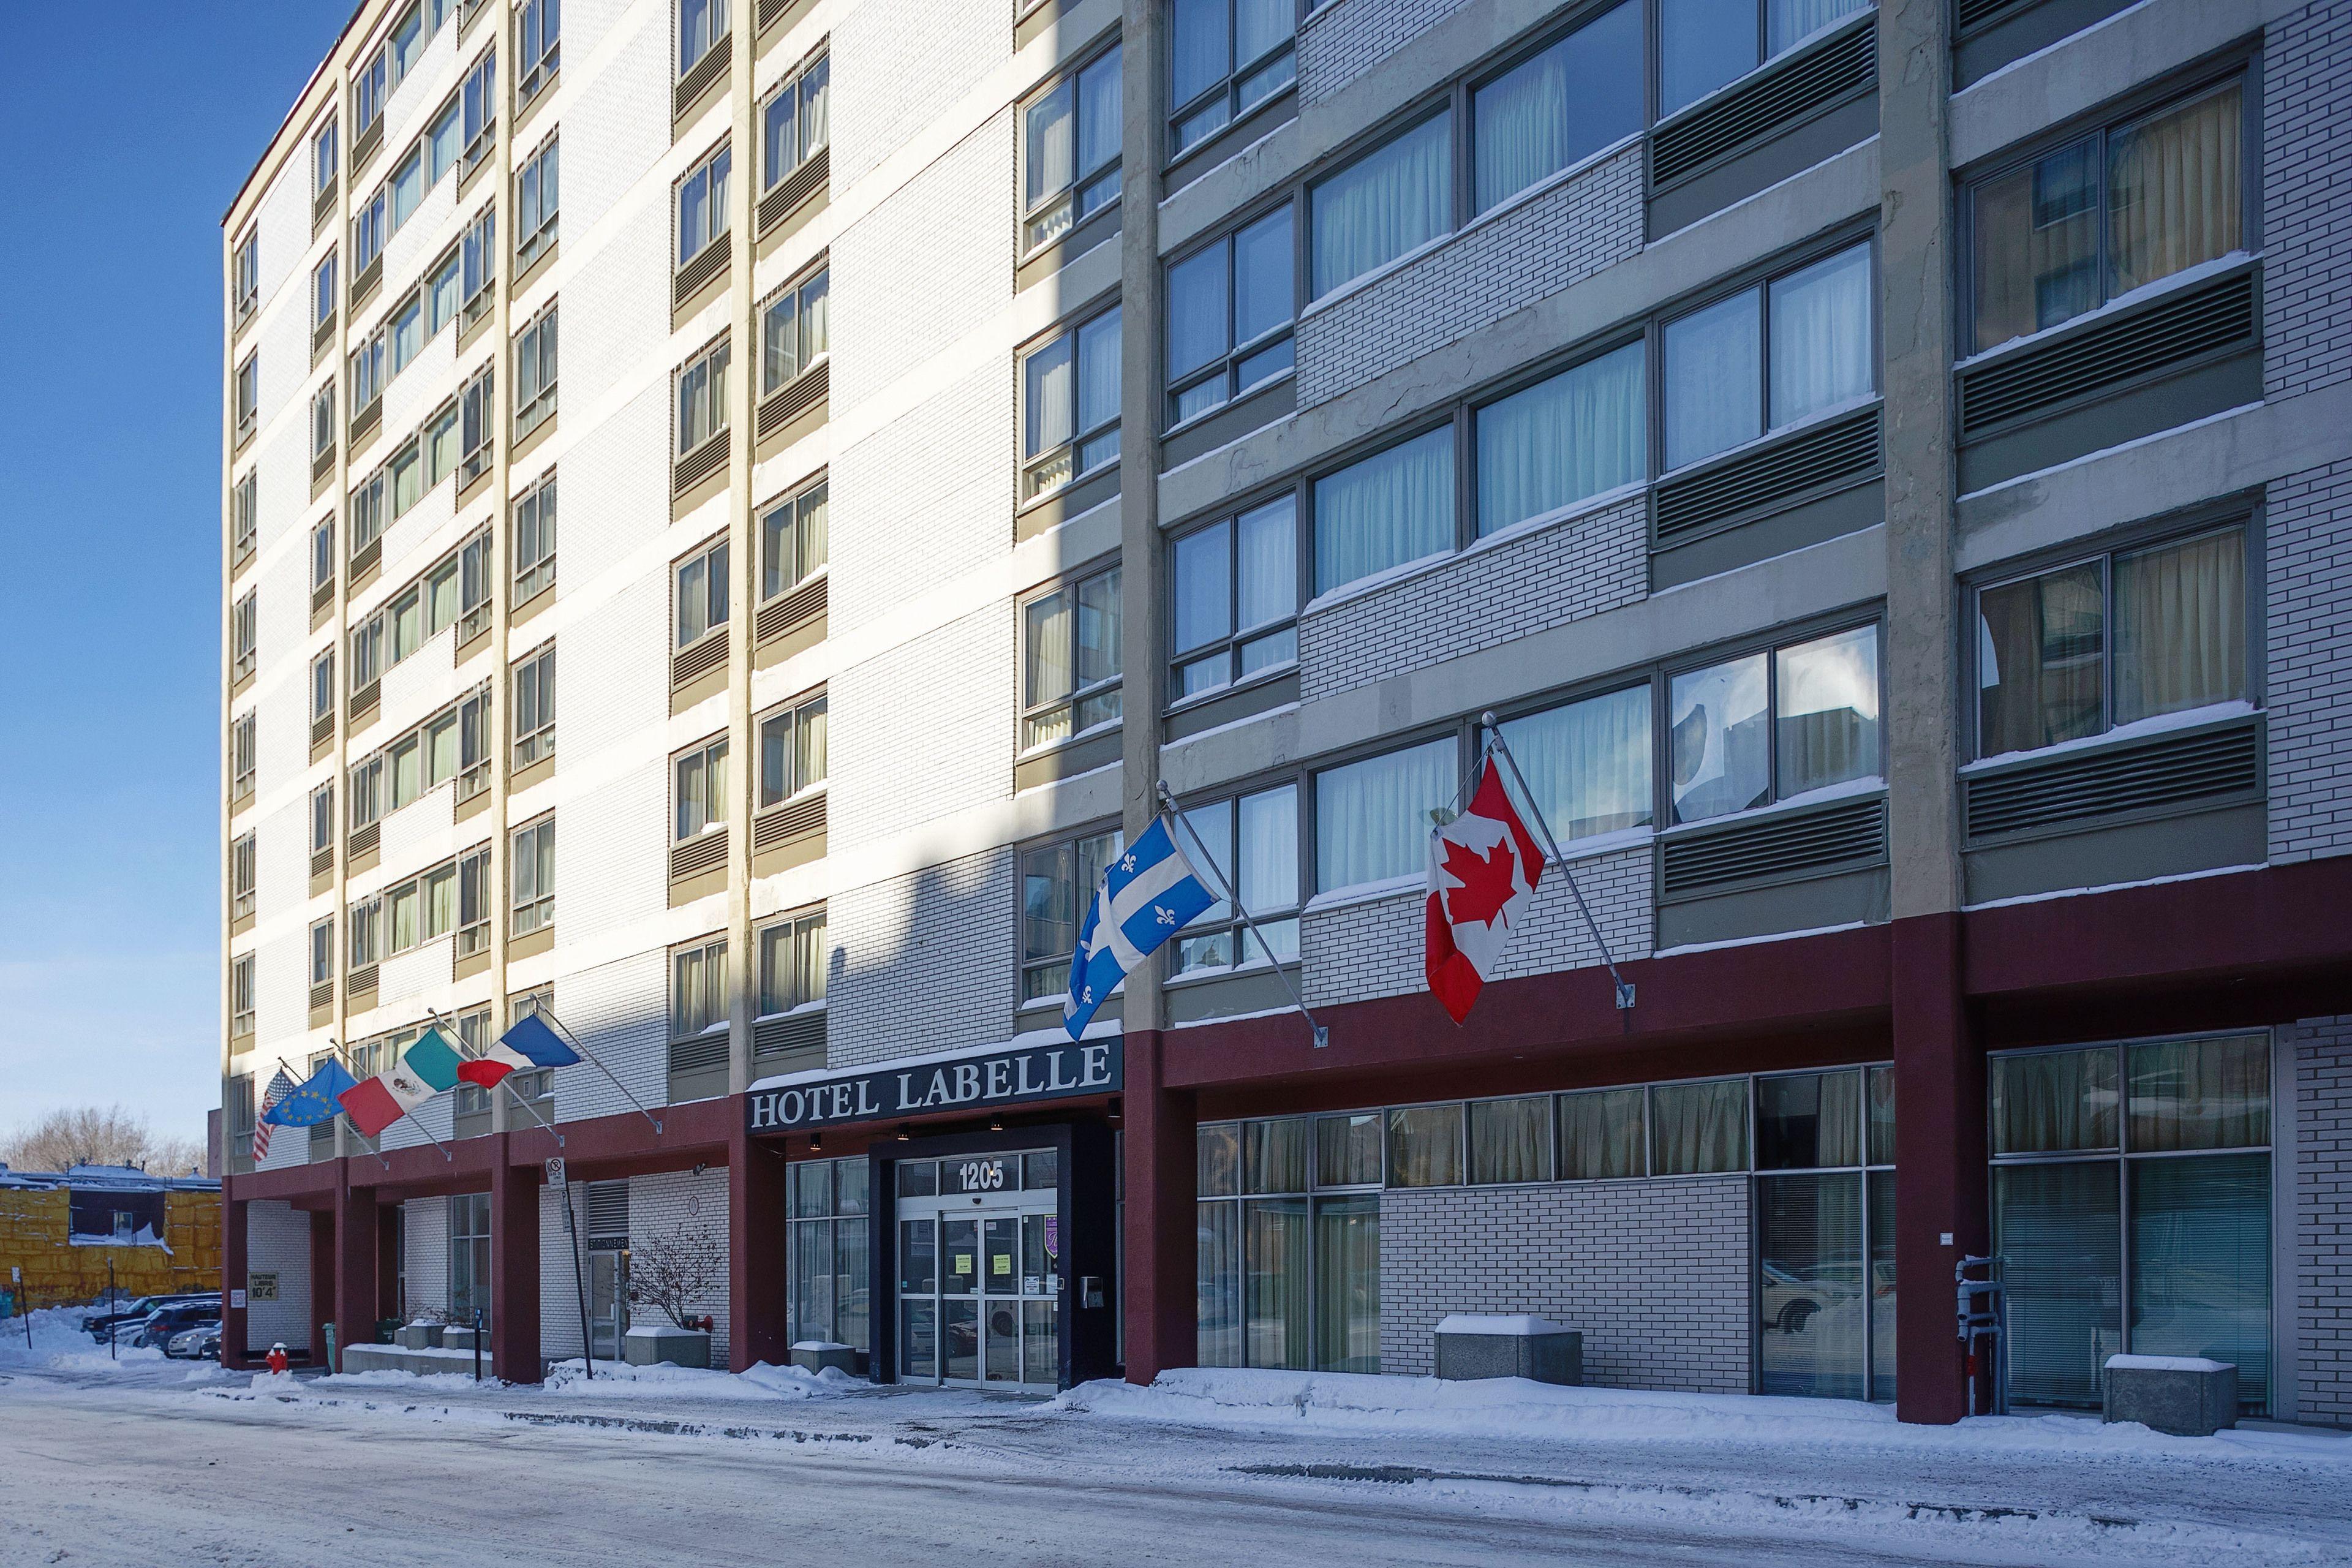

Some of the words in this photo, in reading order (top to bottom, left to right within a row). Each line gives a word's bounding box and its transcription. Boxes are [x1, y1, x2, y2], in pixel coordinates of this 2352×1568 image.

[751, 1079, 880, 1129] HOTEL
[896, 1044, 1112, 1110] LABELLE
[959, 1160, 1004, 1191] 1205
[589, 1238, 628, 1249] STATIONNEMEN
